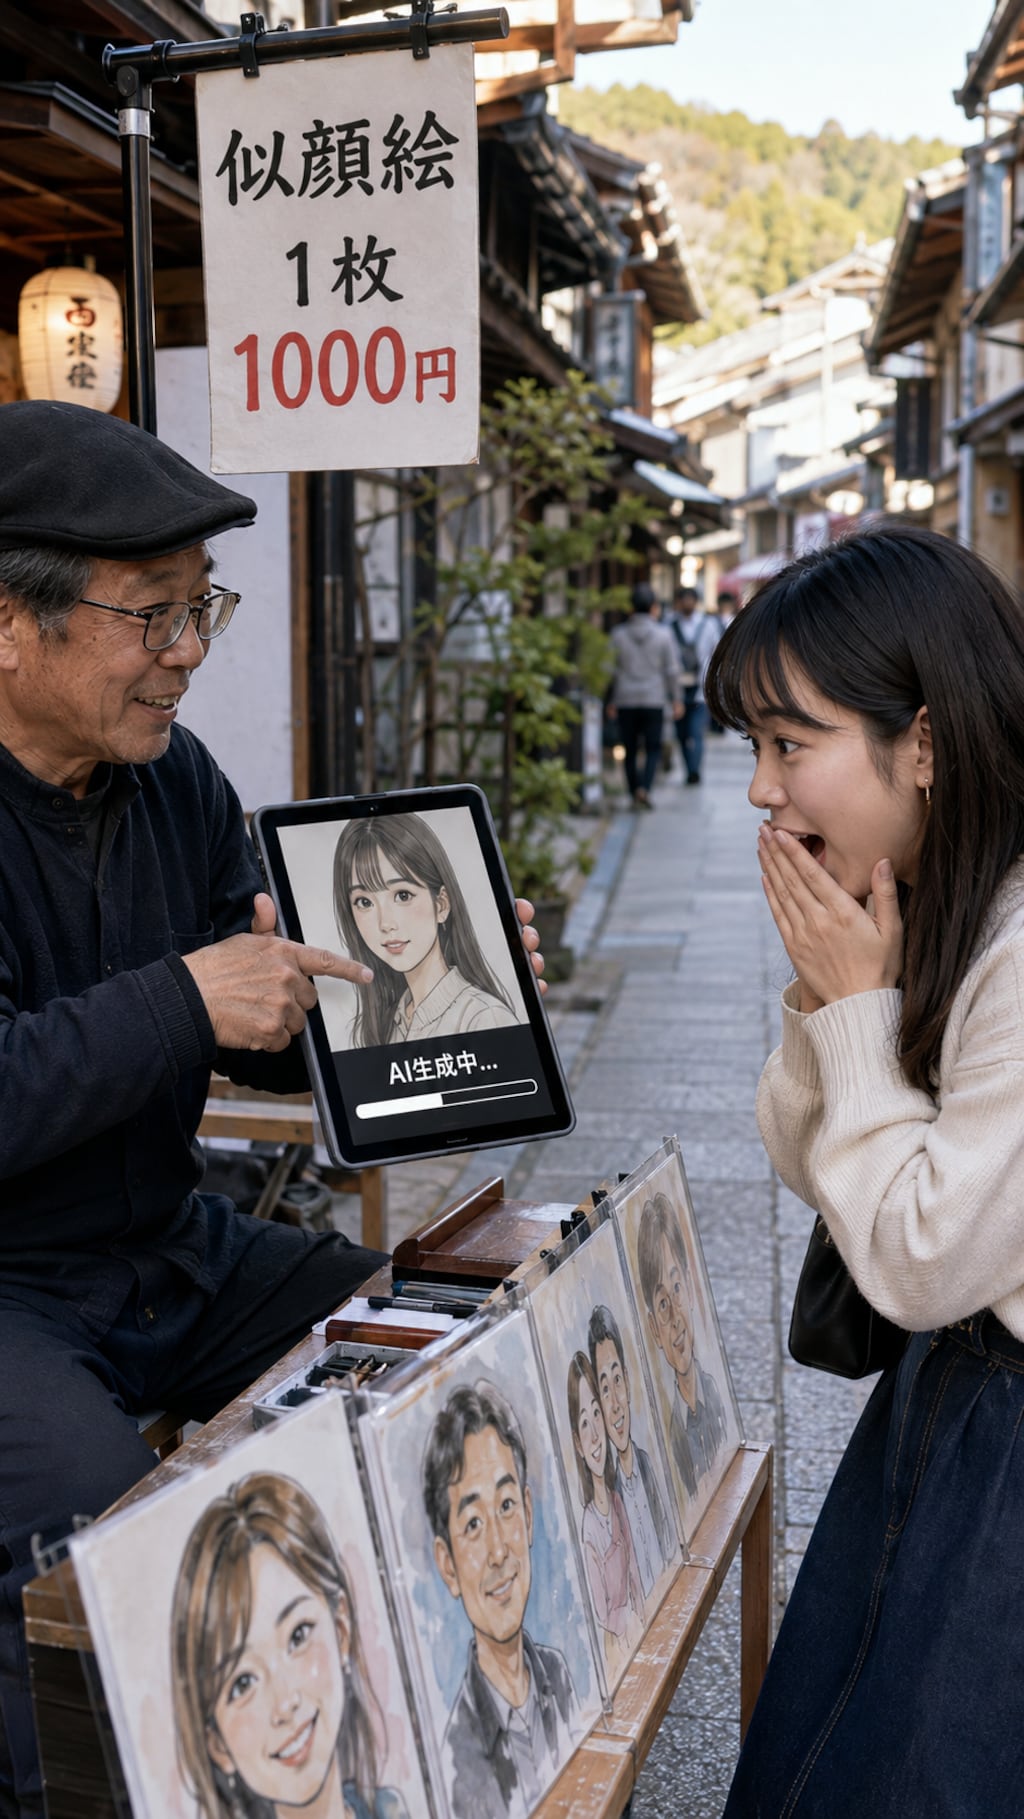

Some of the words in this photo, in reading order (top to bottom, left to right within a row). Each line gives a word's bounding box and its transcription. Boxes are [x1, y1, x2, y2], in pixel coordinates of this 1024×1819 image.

[215, 110, 460, 206] 似顔絵
[285, 234, 404, 308] 1枚
[233, 325, 457, 412] 1000円
